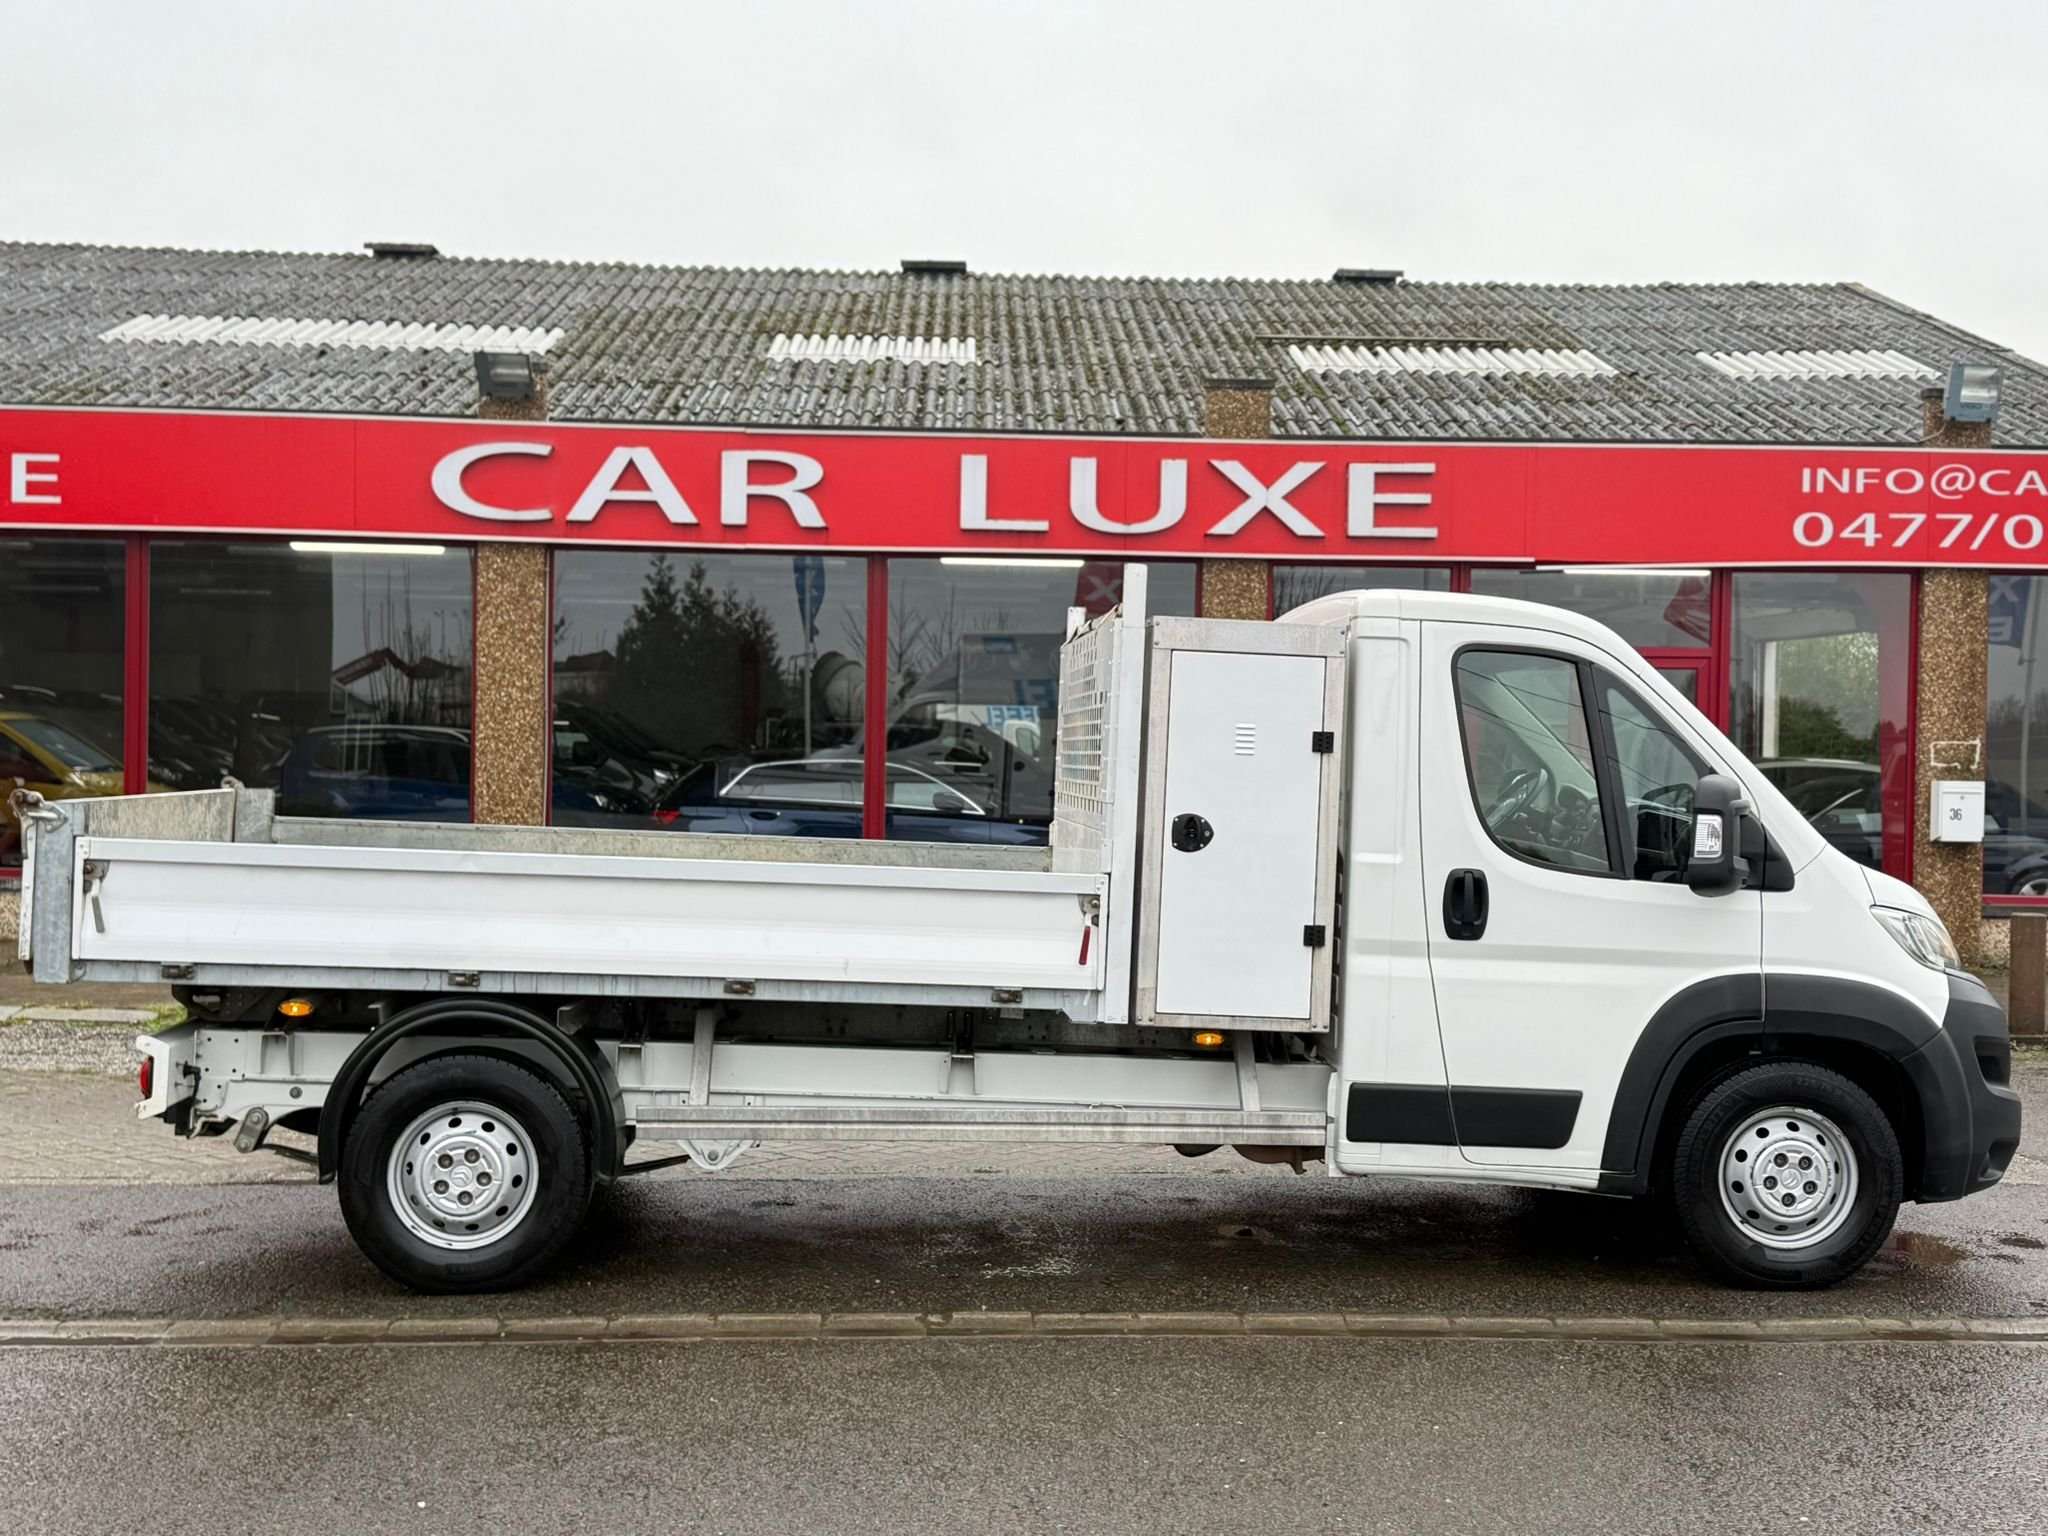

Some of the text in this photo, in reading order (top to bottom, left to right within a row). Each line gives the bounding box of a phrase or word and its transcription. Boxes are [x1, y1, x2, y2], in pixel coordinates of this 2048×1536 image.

[11, 452, 62, 504] E
[431, 441, 1439, 538] CAR LUXE
[1792, 511, 2044, 550] 0477/0
[1949, 807, 1962, 821] 36
